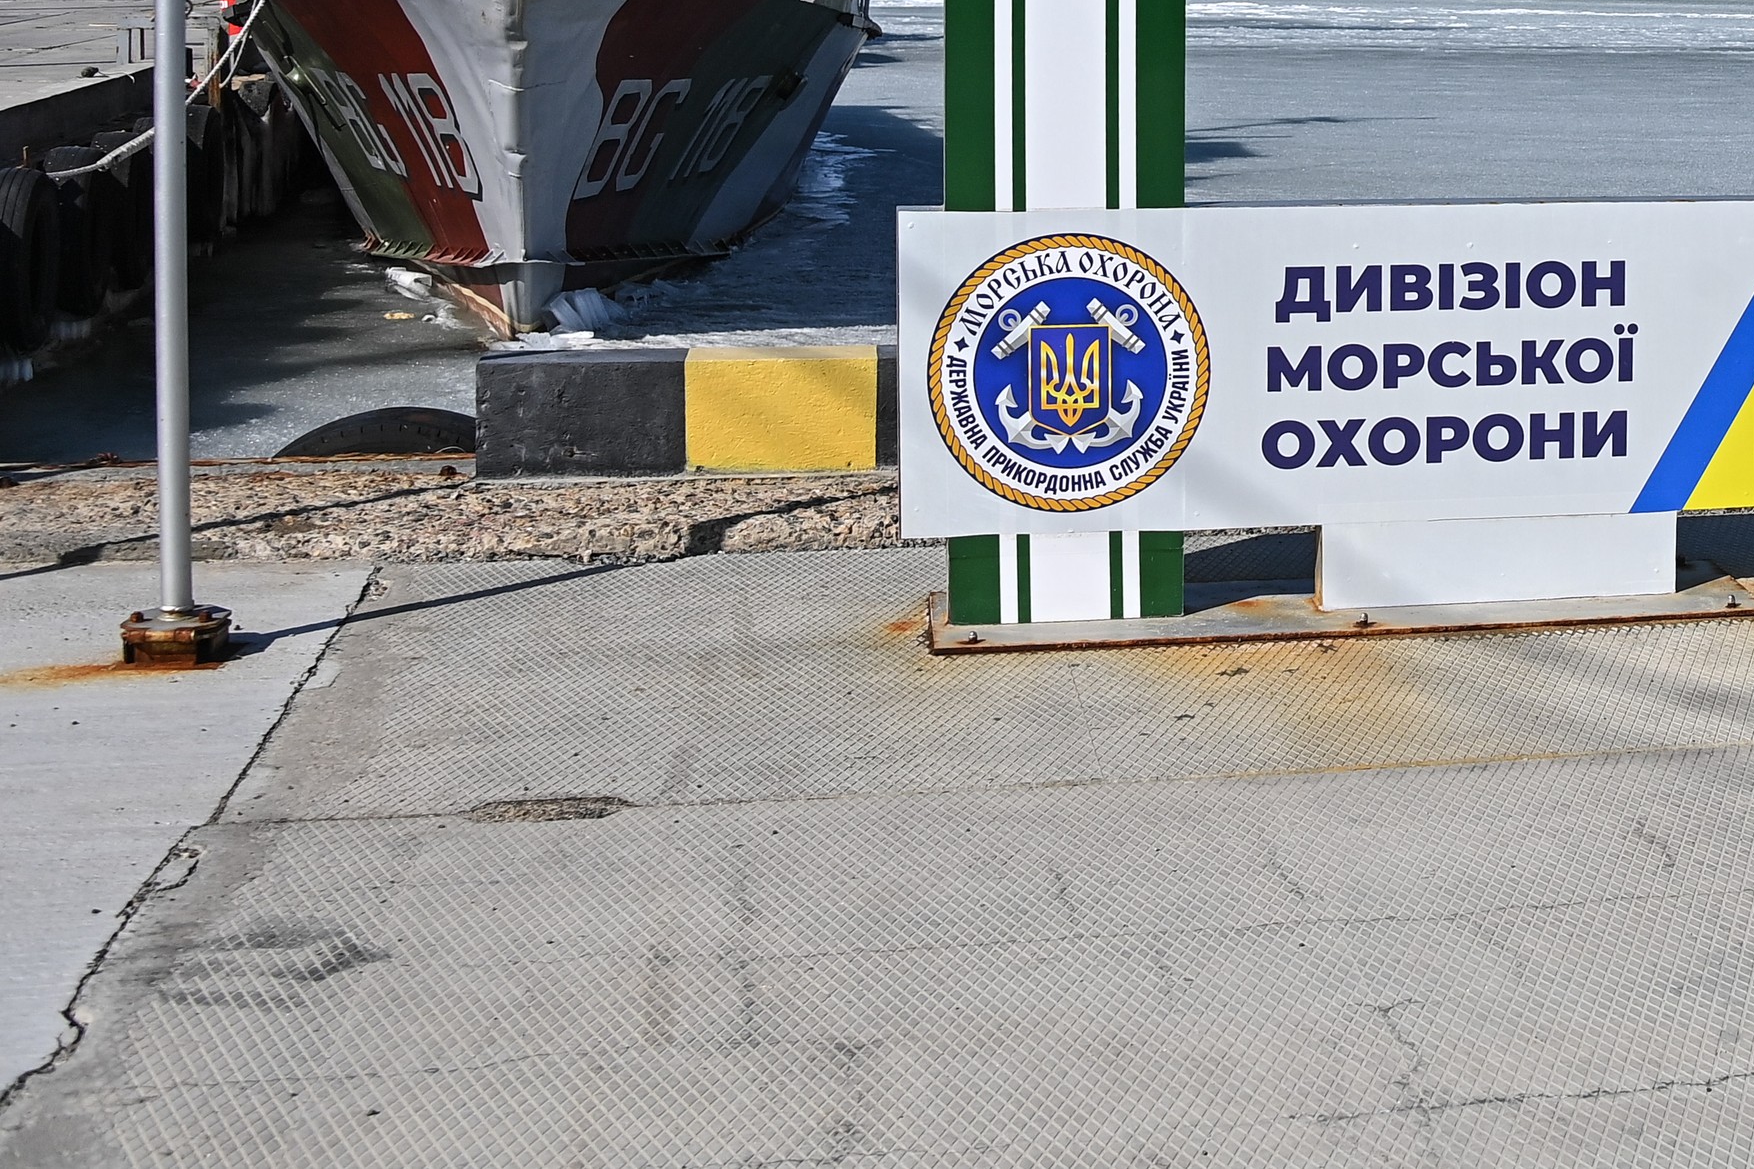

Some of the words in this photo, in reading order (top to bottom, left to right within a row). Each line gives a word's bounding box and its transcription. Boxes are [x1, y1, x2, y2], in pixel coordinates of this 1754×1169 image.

[377, 72, 483, 201] 118
[668, 75, 774, 181] 118
[960, 250, 1073, 336] МОРСЬКА
[1078, 251, 1182, 332] ОХОРОНА
[1275, 260, 1626, 323] ДИВІЗІОН
[1267, 323, 1639, 392] МОРСЬКОЇ
[946, 355, 988, 450] ДЕРЖАВНА
[981, 445, 1107, 495] ПРИКОРДОННА
[1110, 428, 1173, 481] СЛУЖБА
[1162, 348, 1190, 424] УКРАЇНИ
[1261, 410, 1628, 470] ОХОРОНИ
